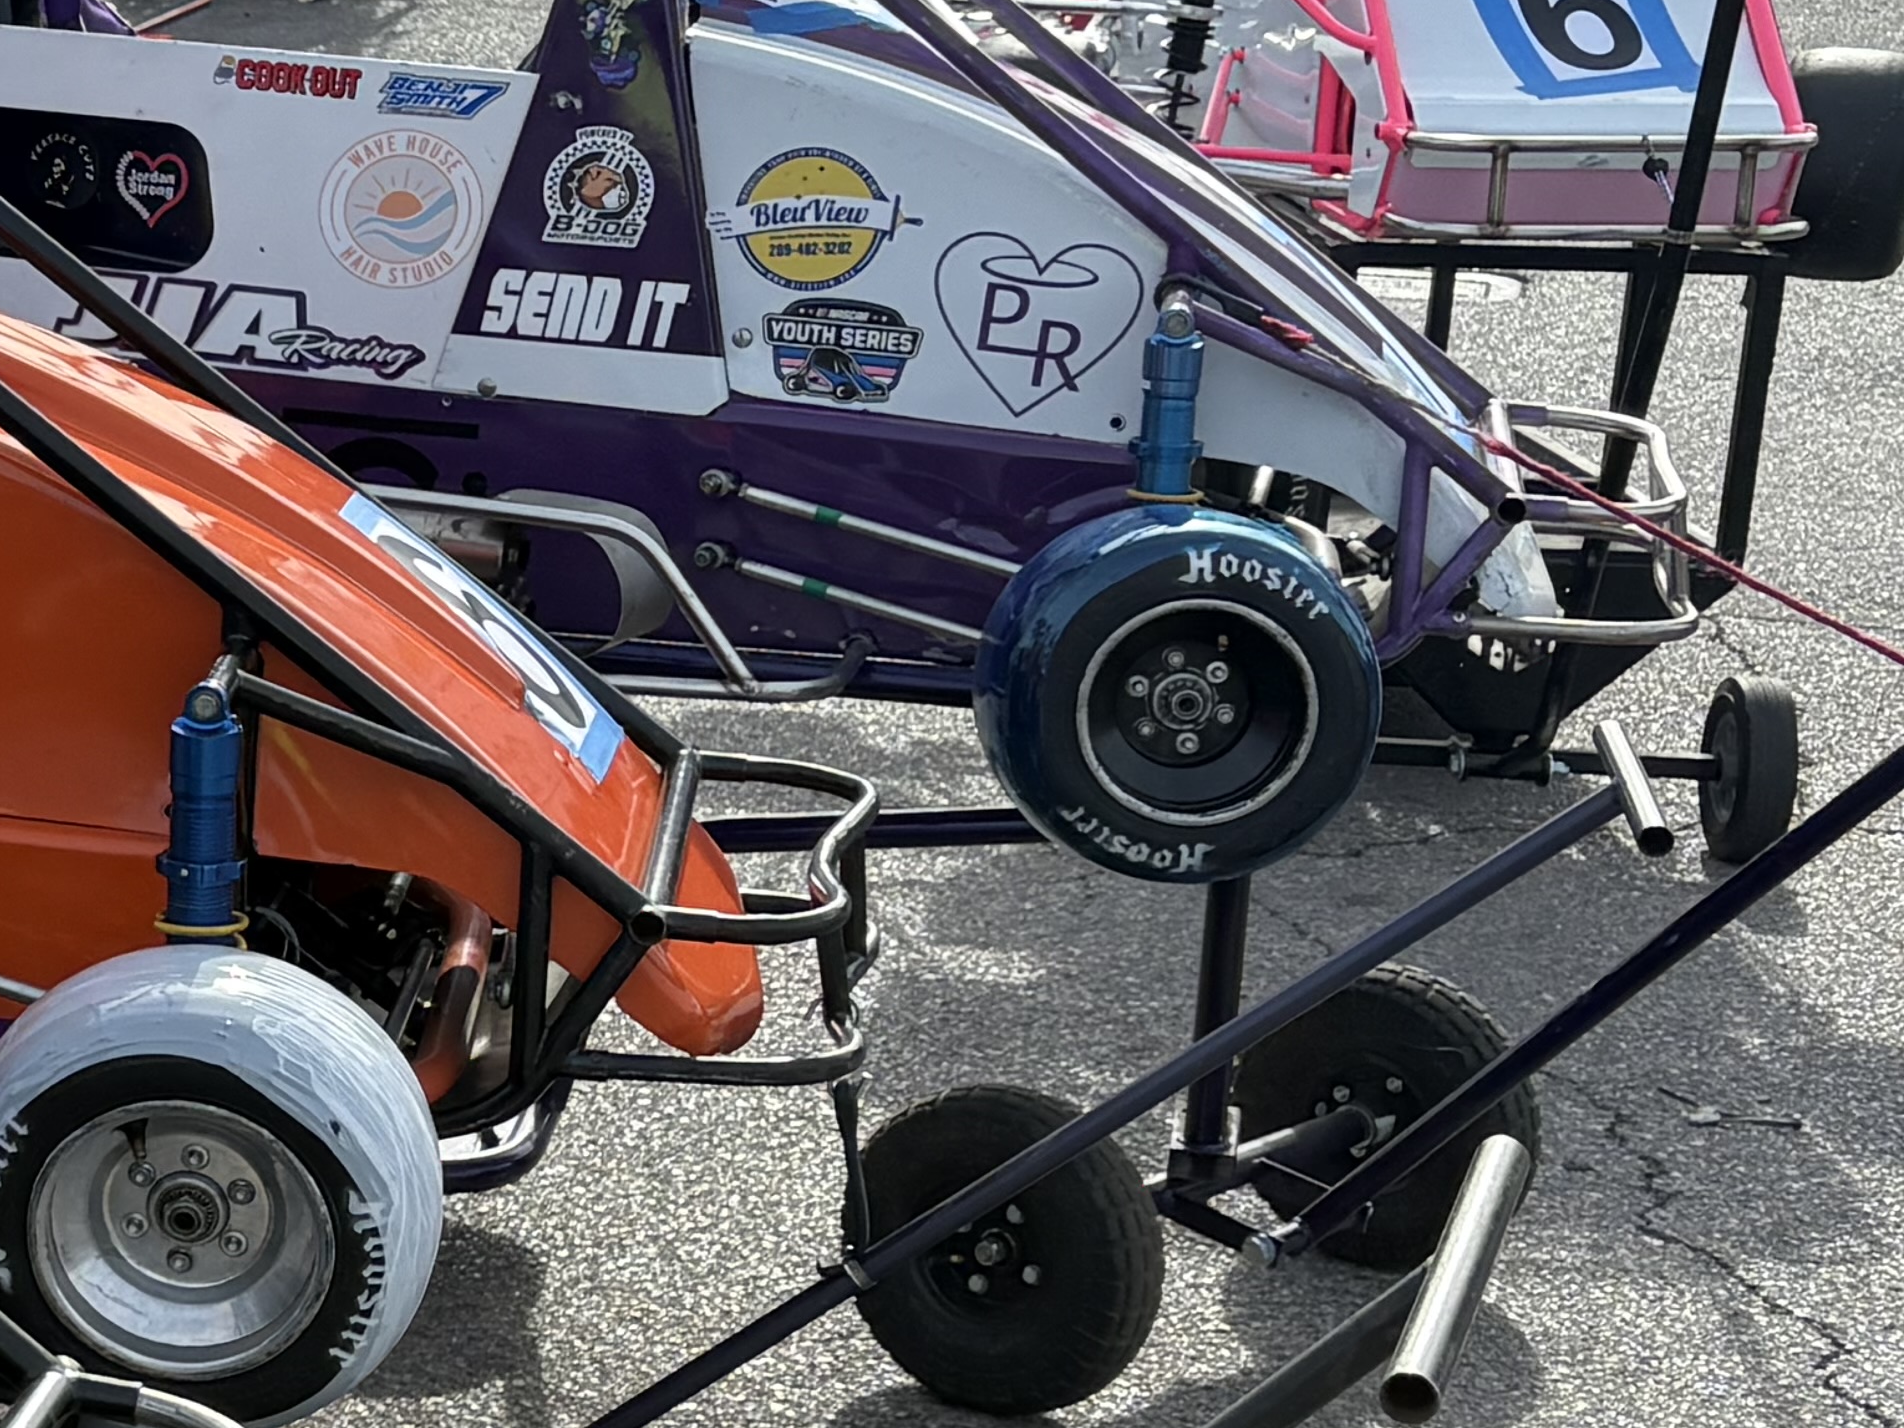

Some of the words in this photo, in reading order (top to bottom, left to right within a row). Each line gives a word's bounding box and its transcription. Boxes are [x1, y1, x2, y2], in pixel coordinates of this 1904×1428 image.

[235, 58, 309, 95] COOK
[310, 65, 363, 100] OUT
[346, 134, 399, 169] WAVE
[405, 134, 464, 174] HOUSE
[127, 168, 176, 185] Jordan
[127, 181, 175, 201] Strong
[550, 213, 642, 238] B-DOG
[749, 198, 870, 228] BleuView
[339, 244, 380, 280] HAIR
[388, 248, 455, 285] STUDIO
[481, 268, 624, 343] SEND
[628, 278, 692, 348] IT
[829, 308, 870, 321] NASCAR
[268, 328, 416, 376] Racing
[770, 320, 836, 345] YOUTH
[840, 327, 914, 353] SERIES
[1179, 543, 1333, 622] Hoosier
[1061, 802, 1216, 876] Hoosier
